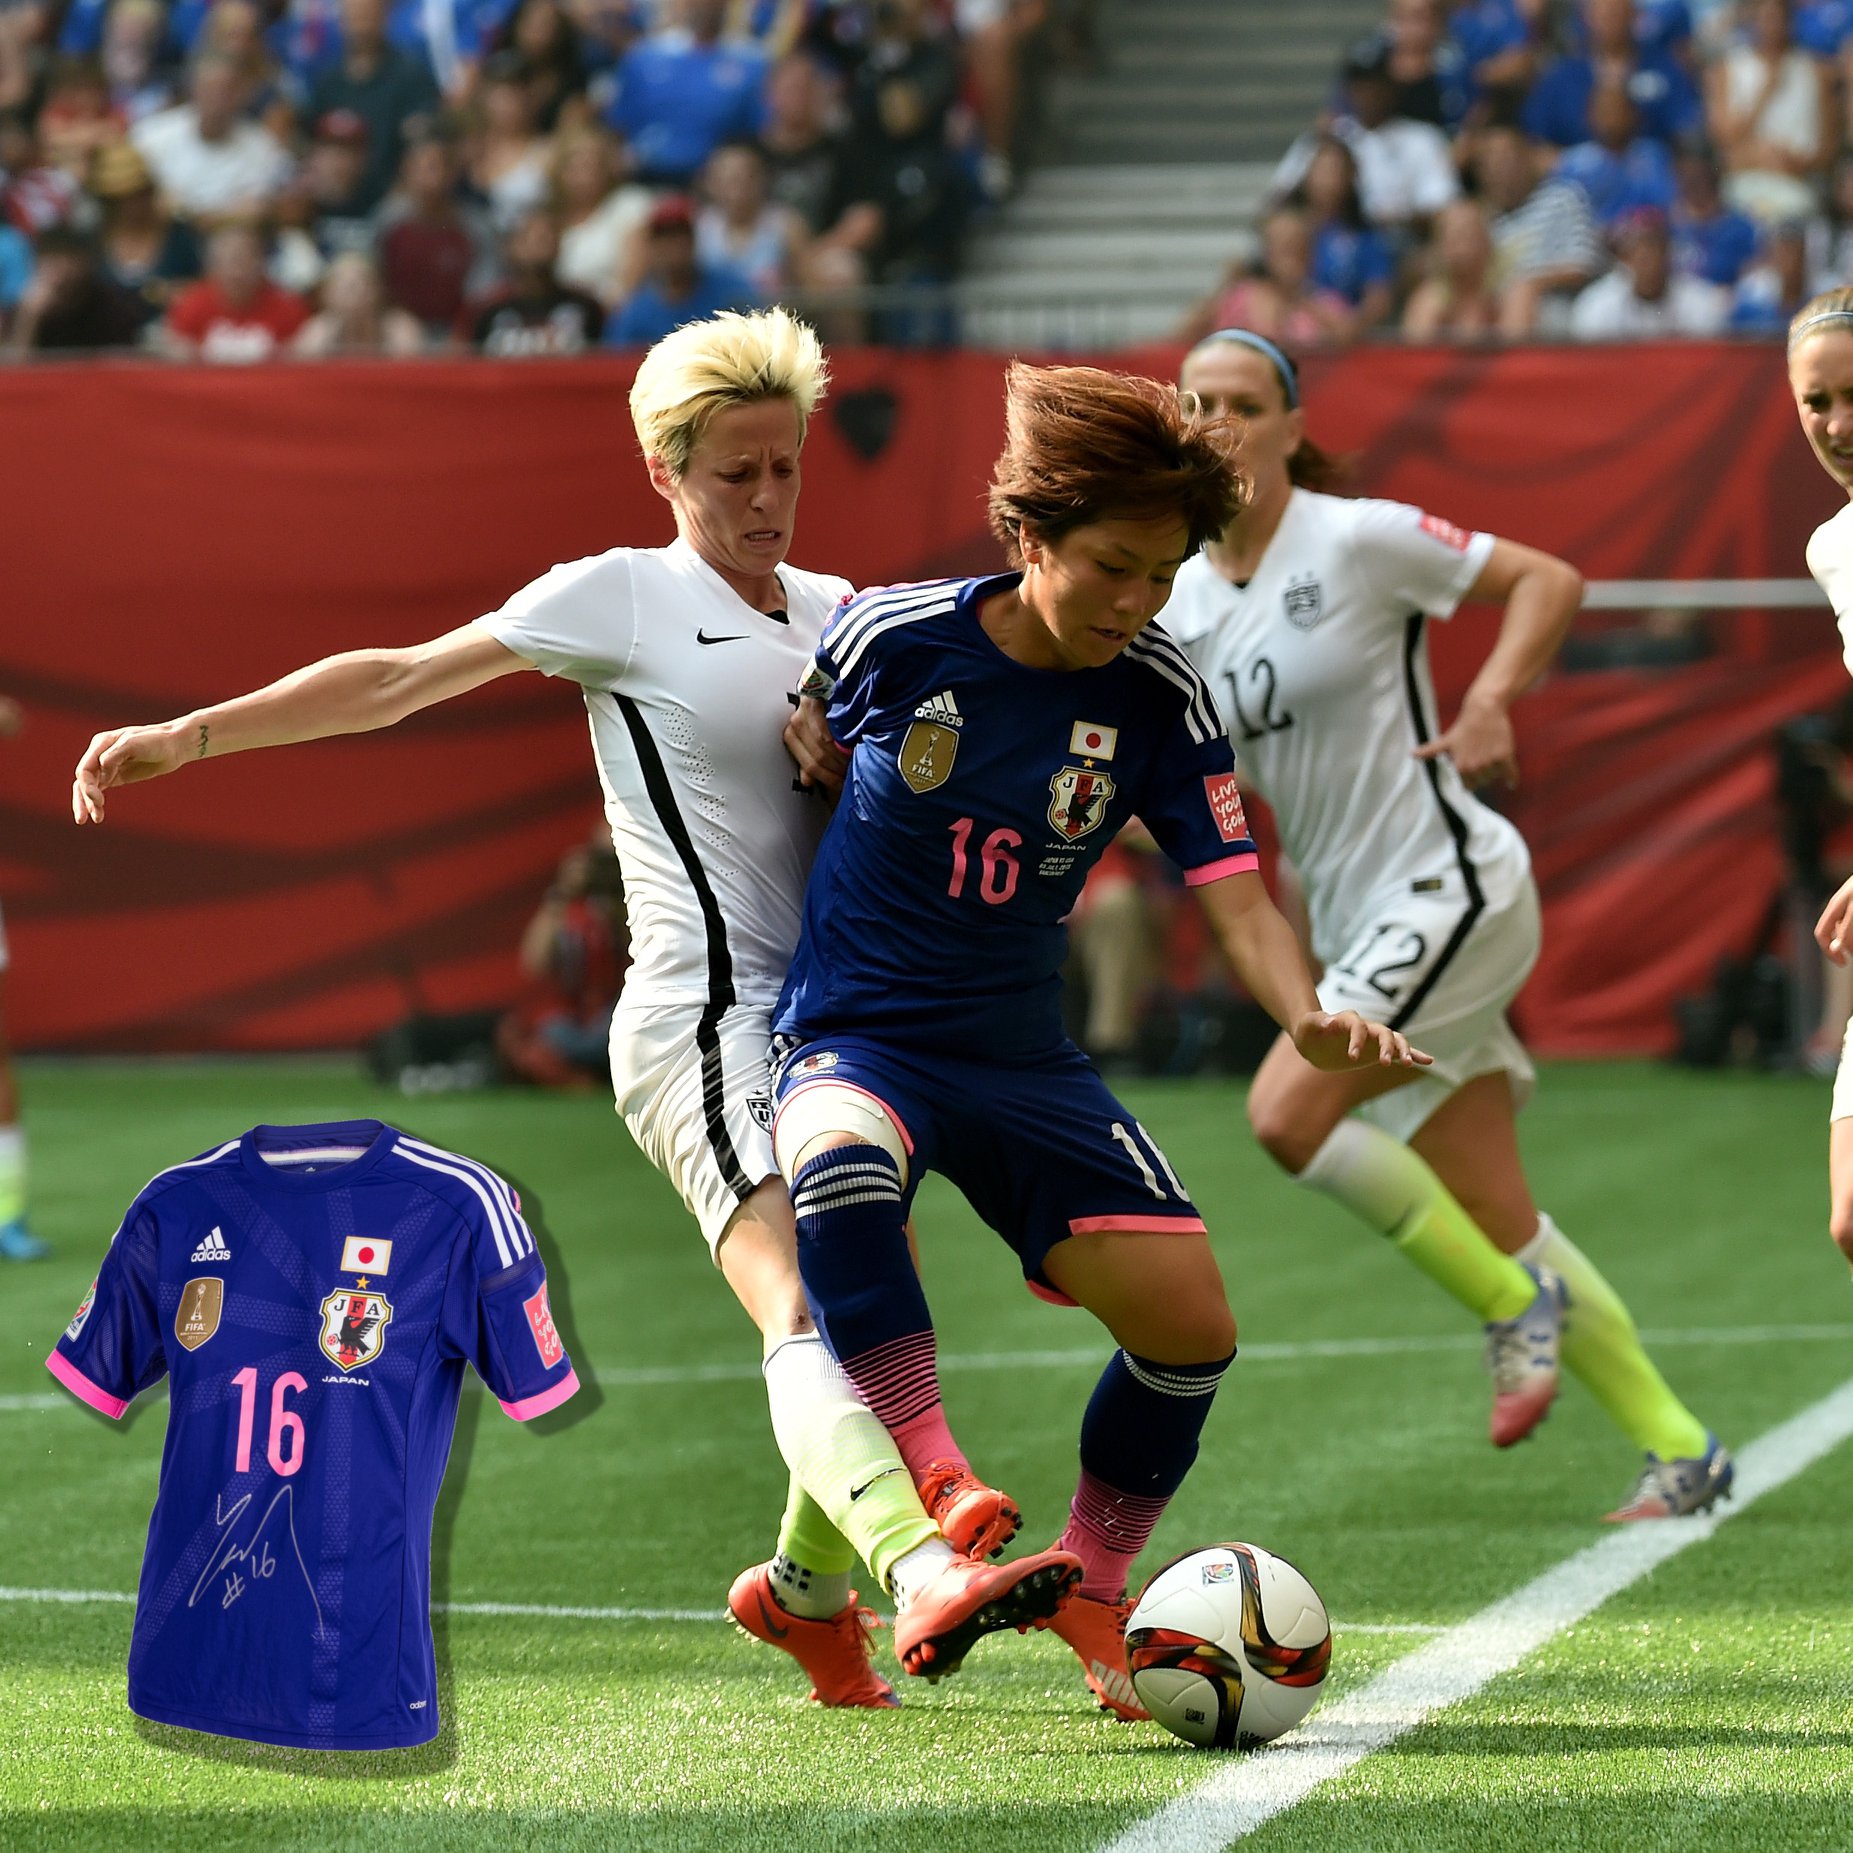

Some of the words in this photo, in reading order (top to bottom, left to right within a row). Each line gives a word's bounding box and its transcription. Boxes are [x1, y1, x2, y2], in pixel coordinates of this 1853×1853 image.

[1221, 657, 1296, 742] 12
[914, 706, 964, 727] adidas
[912, 763, 934, 778] FIFA
[1211, 779, 1238, 804] LIVE
[1045, 842, 1087, 851] JAPAN
[947, 816, 1023, 905] 16
[190, 1247, 231, 1263] adidas
[333, 1298, 381, 1316] JFA
[185, 1322, 204, 1332] FIFA
[321, 1375, 370, 1386] JAPAN
[230, 1366, 309, 1477] 16
